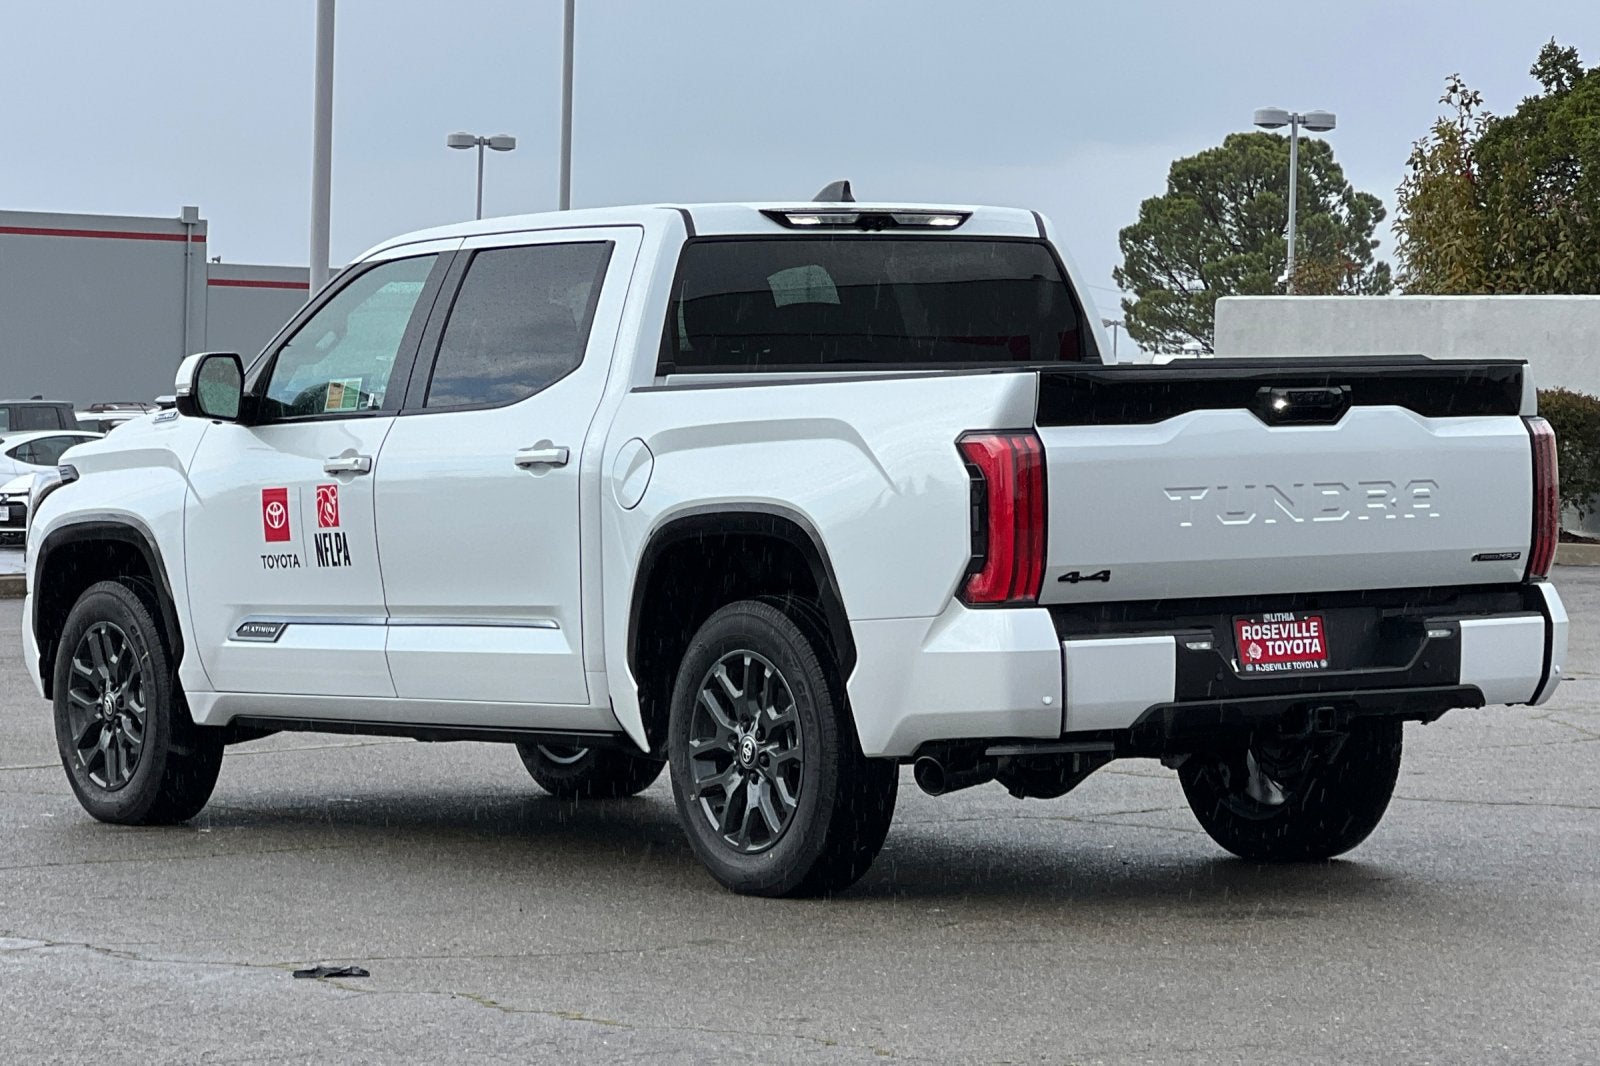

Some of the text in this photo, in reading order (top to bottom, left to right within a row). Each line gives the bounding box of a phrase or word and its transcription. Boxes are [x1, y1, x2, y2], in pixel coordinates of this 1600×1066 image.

[1164, 479, 1440, 526] TUNDRA
[314, 531, 352, 568] NFLPA
[261, 554, 301, 569] TOYOTA
[1270, 612, 1296, 622] LITHIA
[242, 625, 276, 633] PLATINUM
[1241, 622, 1319, 641] ROSEVILLE
[1266, 639, 1322, 656] TOYOTA
[1255, 661, 1319, 672] ROSEVILLE TOYOTA
